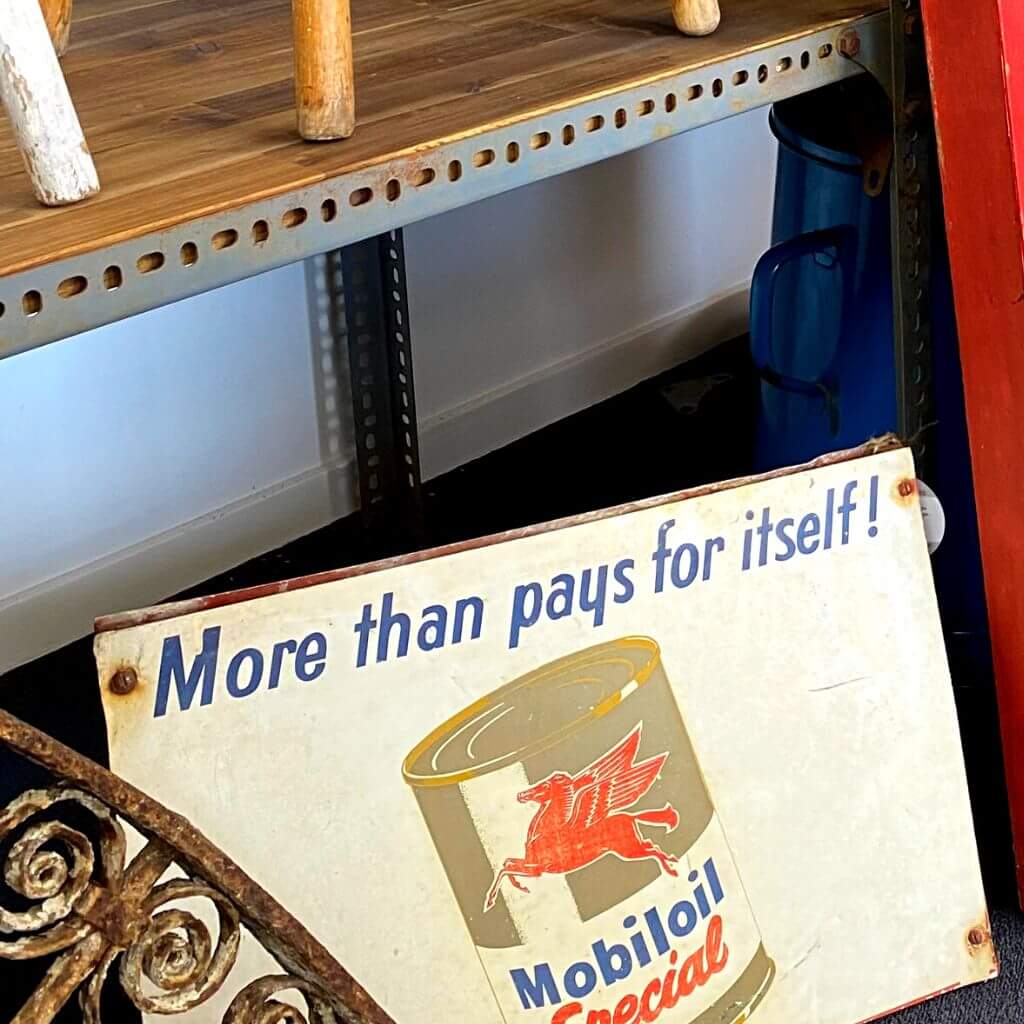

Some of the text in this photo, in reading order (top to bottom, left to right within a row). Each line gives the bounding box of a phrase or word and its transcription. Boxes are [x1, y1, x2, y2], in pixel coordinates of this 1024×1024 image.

[153, 474, 880, 718] More than pays for itself!
[509, 856, 725, 1010] Mobiloil
